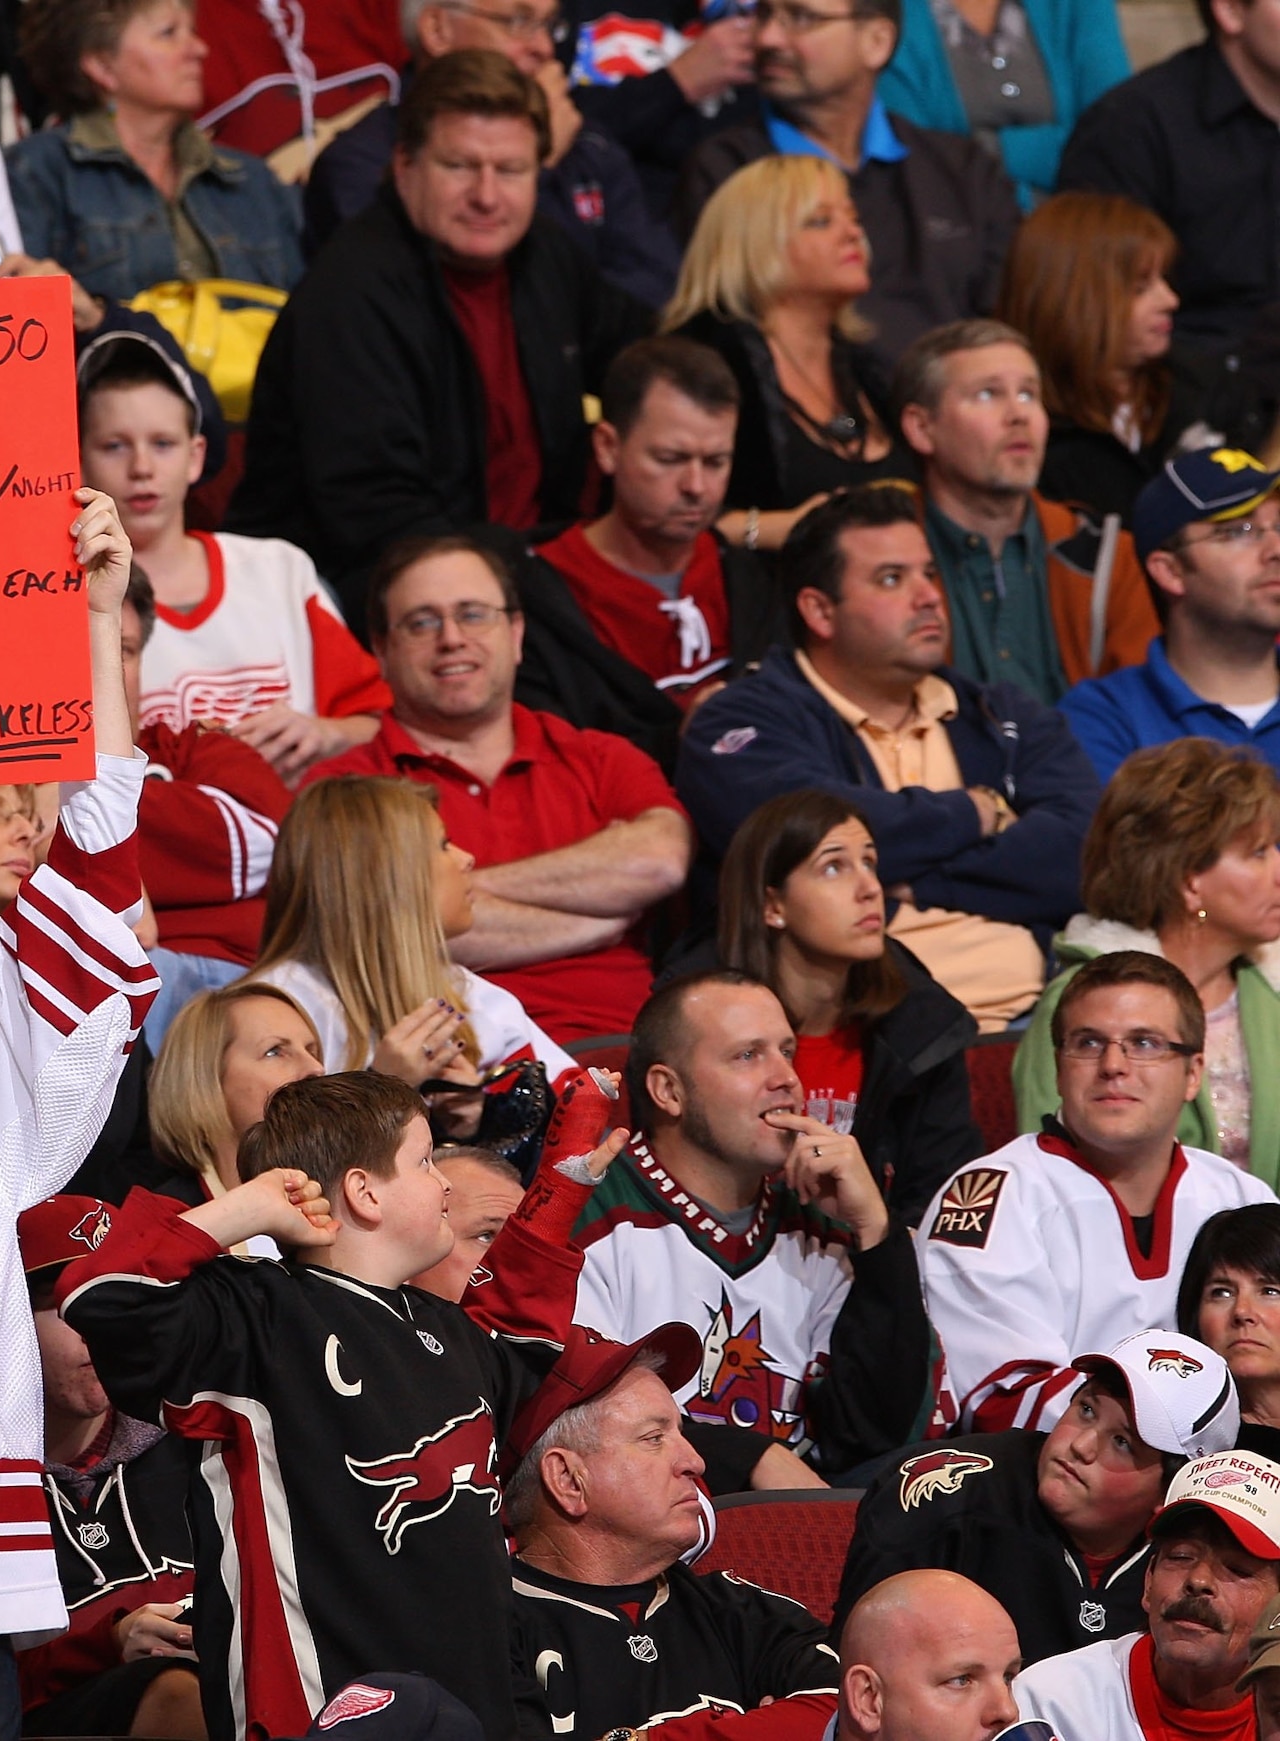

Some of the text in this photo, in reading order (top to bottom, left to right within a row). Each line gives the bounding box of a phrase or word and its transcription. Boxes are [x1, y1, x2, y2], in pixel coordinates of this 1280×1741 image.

[3, 566, 85, 598] EACH
[934, 1211, 986, 1234] PHX
[324, 1334, 362, 1397] C
[1187, 1458, 1228, 1478] SWEET
[1222, 1491, 1267, 1516] CHAMPIONS
